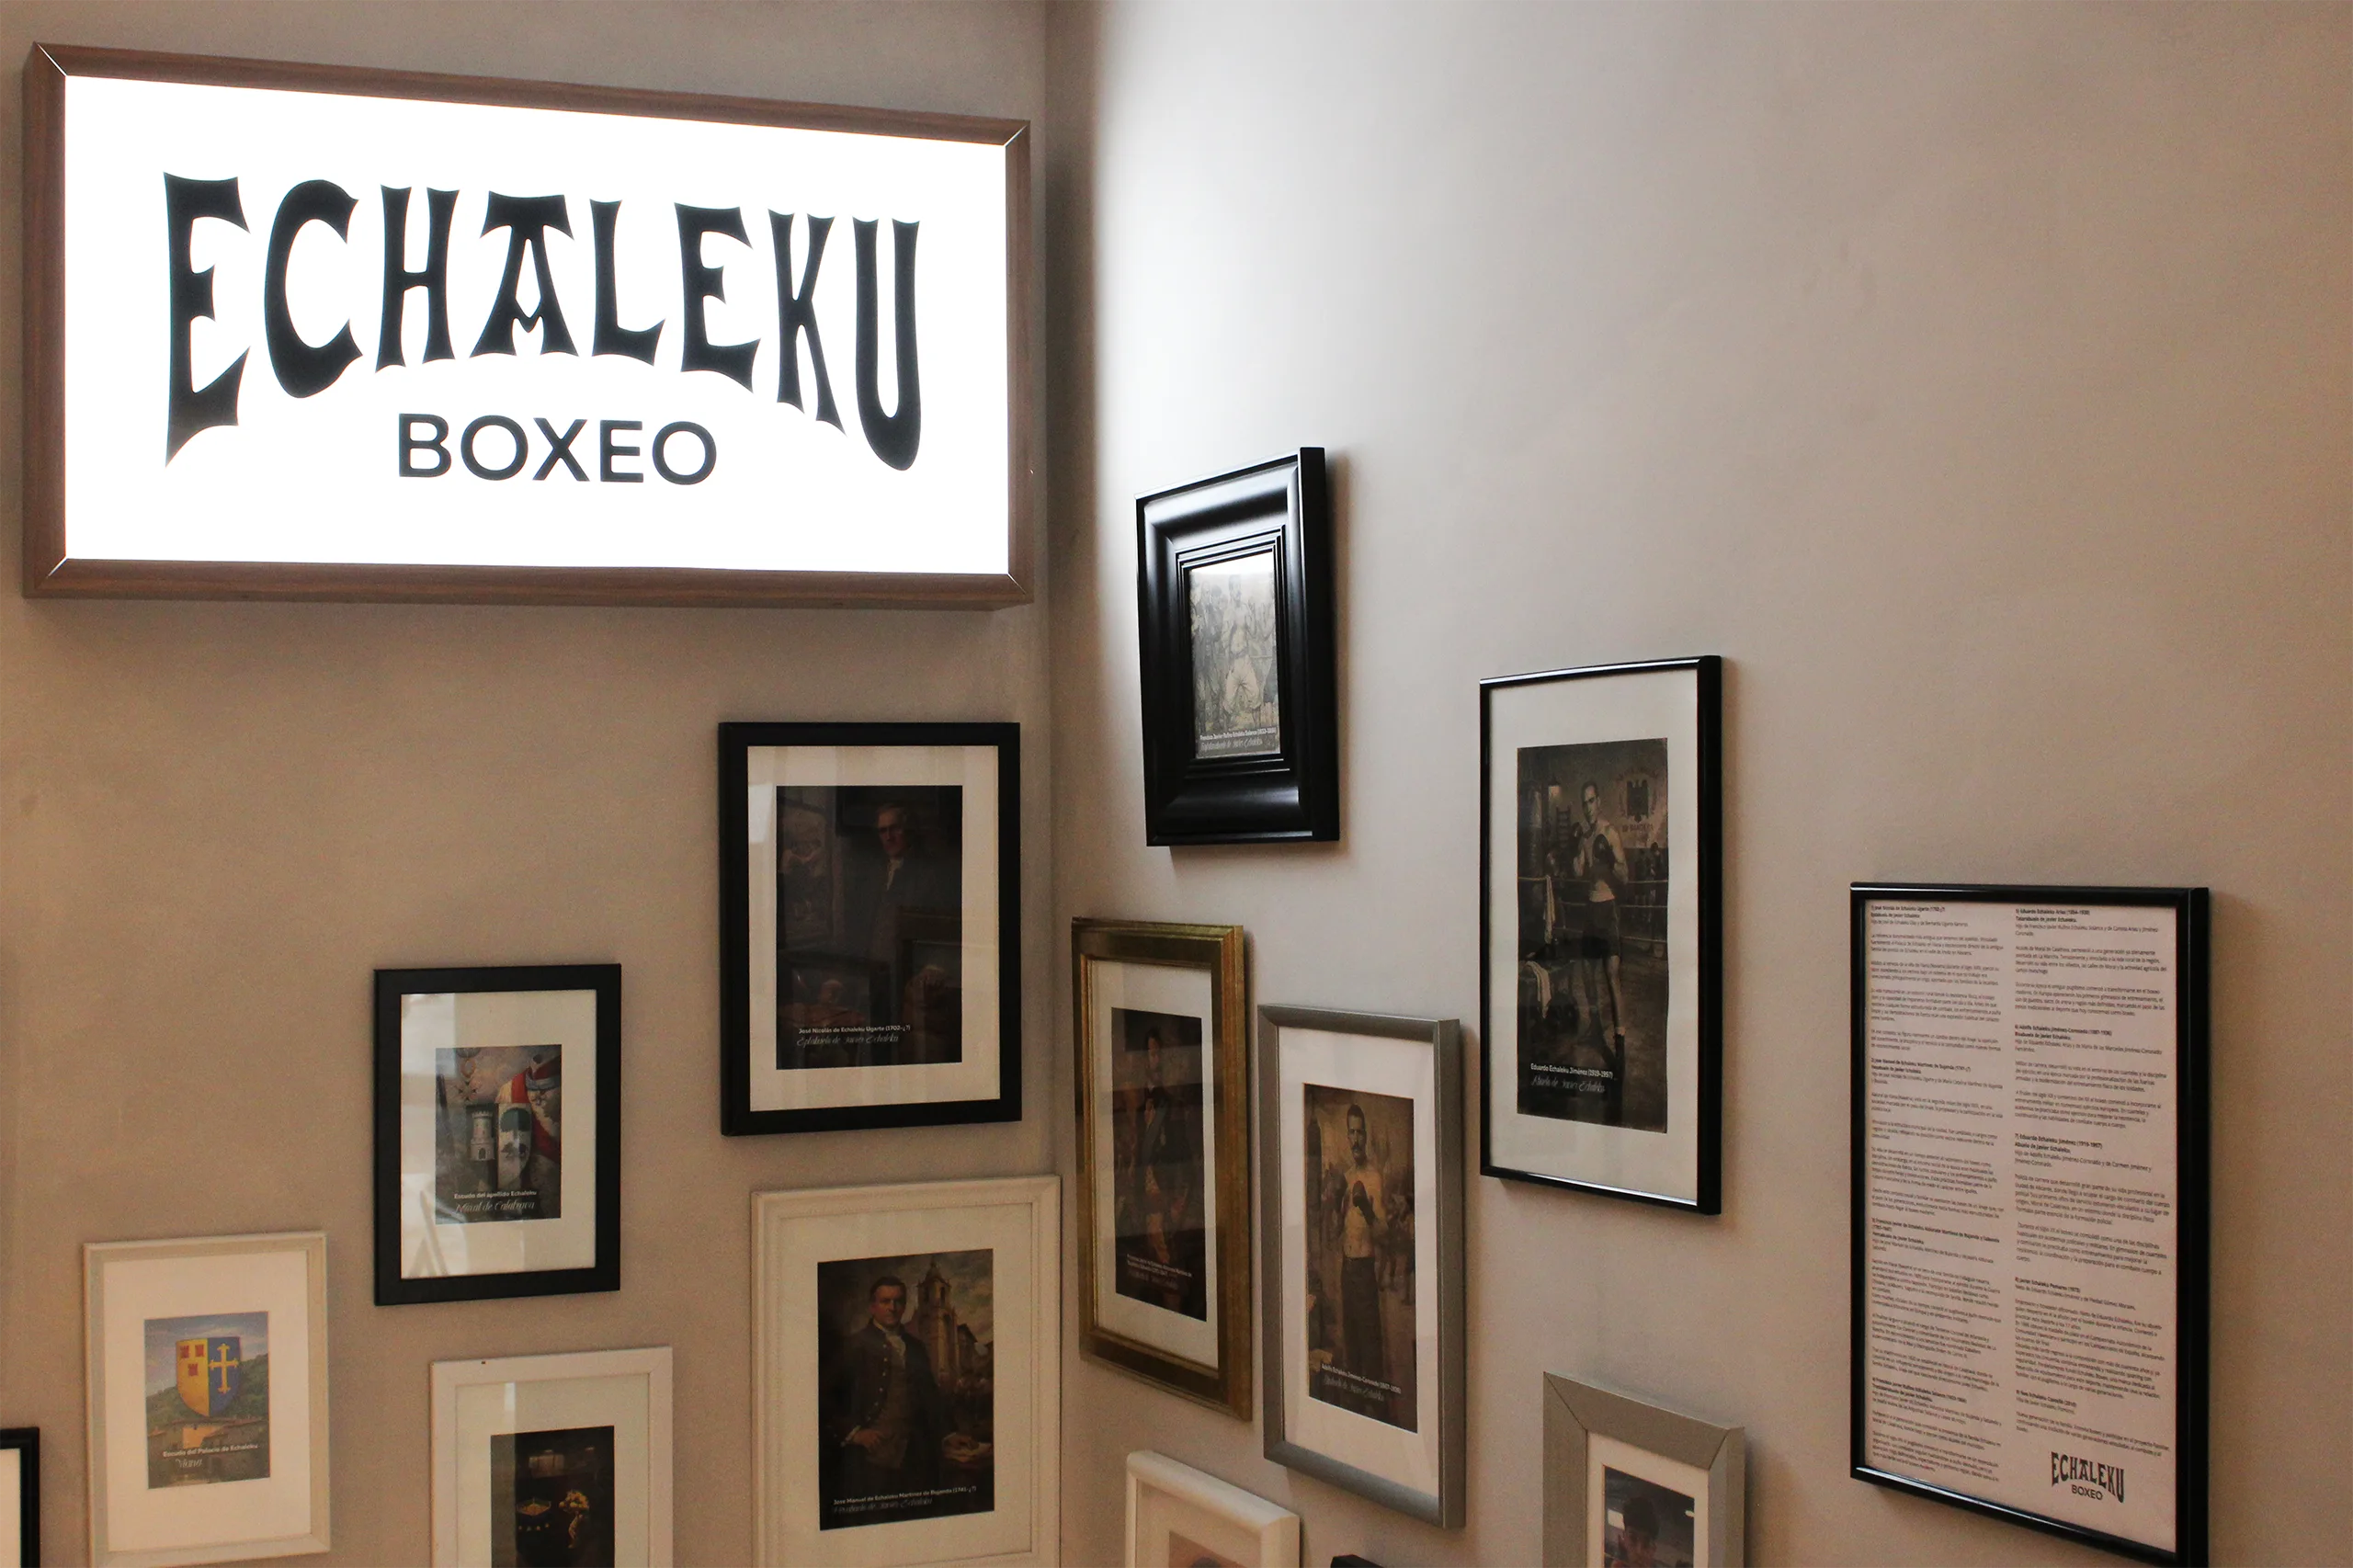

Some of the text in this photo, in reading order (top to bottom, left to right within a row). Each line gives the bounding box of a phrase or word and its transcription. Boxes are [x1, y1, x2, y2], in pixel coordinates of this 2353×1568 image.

[164, 172, 921, 472] ECHALEKU
[400, 414, 716, 484] BOXEO
[866, 1026, 885, 1034] Ugarte
[1530, 1062, 1549, 1072] Eduardo
[1549, 1064, 1569, 1074] Echaleku
[2038, 1135, 2057, 1144] Echaleku
[483, 1200, 493, 1210] de
[164, 1449, 188, 1458] Escudo
[199, 1447, 222, 1455] Palacio
[2051, 1451, 2124, 1503] ECHALEKU
[2071, 1484, 2103, 1500] BOXEO
